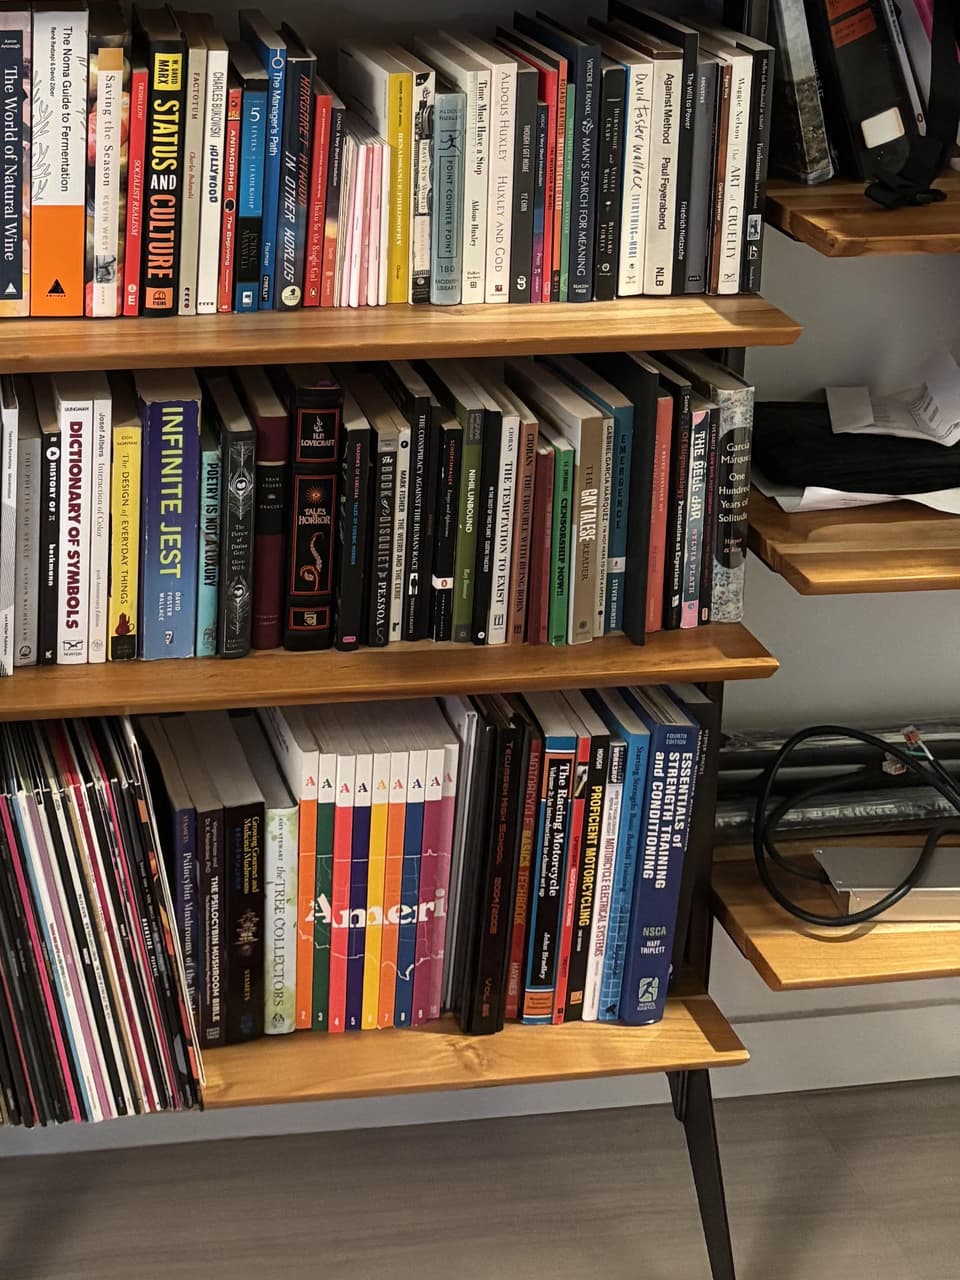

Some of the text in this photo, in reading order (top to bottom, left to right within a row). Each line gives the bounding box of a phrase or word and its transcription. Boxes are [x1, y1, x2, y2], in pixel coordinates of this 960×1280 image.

[61, 26, 73, 192] The Noma Guide to Fermentation
[158, 60, 169, 85] MARX
[4, 66, 17, 261] The World of Natural Wine
[148, 99, 178, 278] STATUS AND CULTURE
[655, 73, 674, 286] Against Method Paul Feyerabend NLB
[66, 421, 83, 629] DICTIONARY OF SYMBOLS
[120, 454, 130, 605] The DESIGN of EVERYDAY THINGS
[158, 407, 184, 579] INFINITE JEST
[495, 461, 513, 605] THE TEMPTATION TO EXIST
[579, 489, 598, 543] GAY TALESE
[578, 785, 602, 926] PROFICIENT MOTORCYCLING
[642, 751, 666, 879] and CONDITIONING
[655, 752, 680, 888] STRENGTH TRAINING
[672, 752, 693, 848] ESSENTIALS of
[273, 879, 286, 1007] TREE COLLECTORS
[643, 927, 667, 936] NSCA
